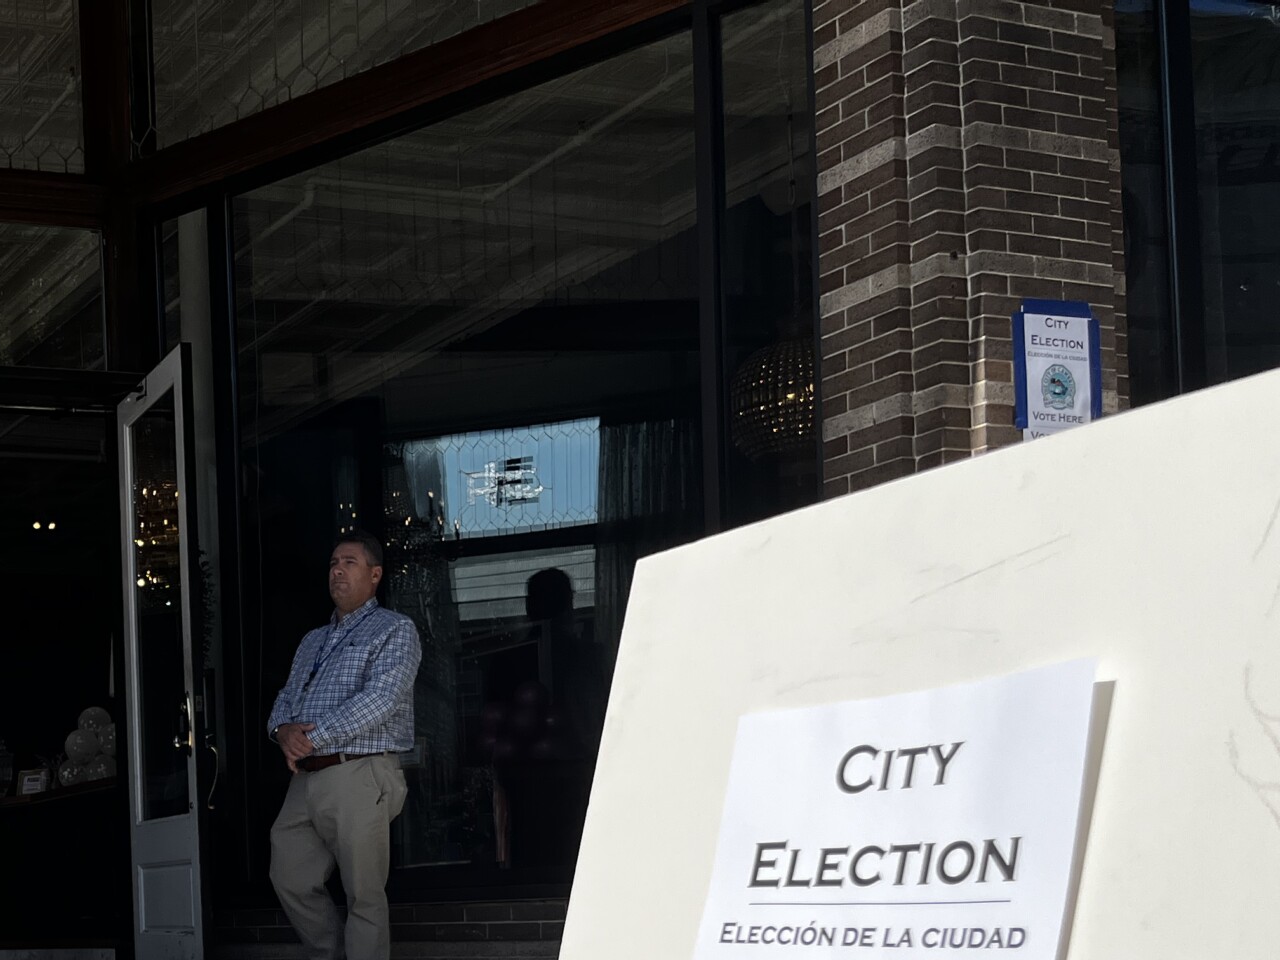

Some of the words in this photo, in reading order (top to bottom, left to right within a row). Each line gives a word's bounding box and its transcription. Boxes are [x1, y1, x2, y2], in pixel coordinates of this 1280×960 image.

[1045, 317, 1069, 329] CITY
[1031, 335, 1083, 350] ELECTION
[1032, 411, 1057, 422] VOTE
[1059, 413, 1084, 424] HERE
[836, 741, 966, 795] CITY
[747, 836, 1023, 890] ELECTION
[718, 920, 838, 947] ELECCIÓN
[841, 926, 878, 949] DE
[882, 926, 916, 949] LA
[920, 925, 1028, 951] CIUDAD
